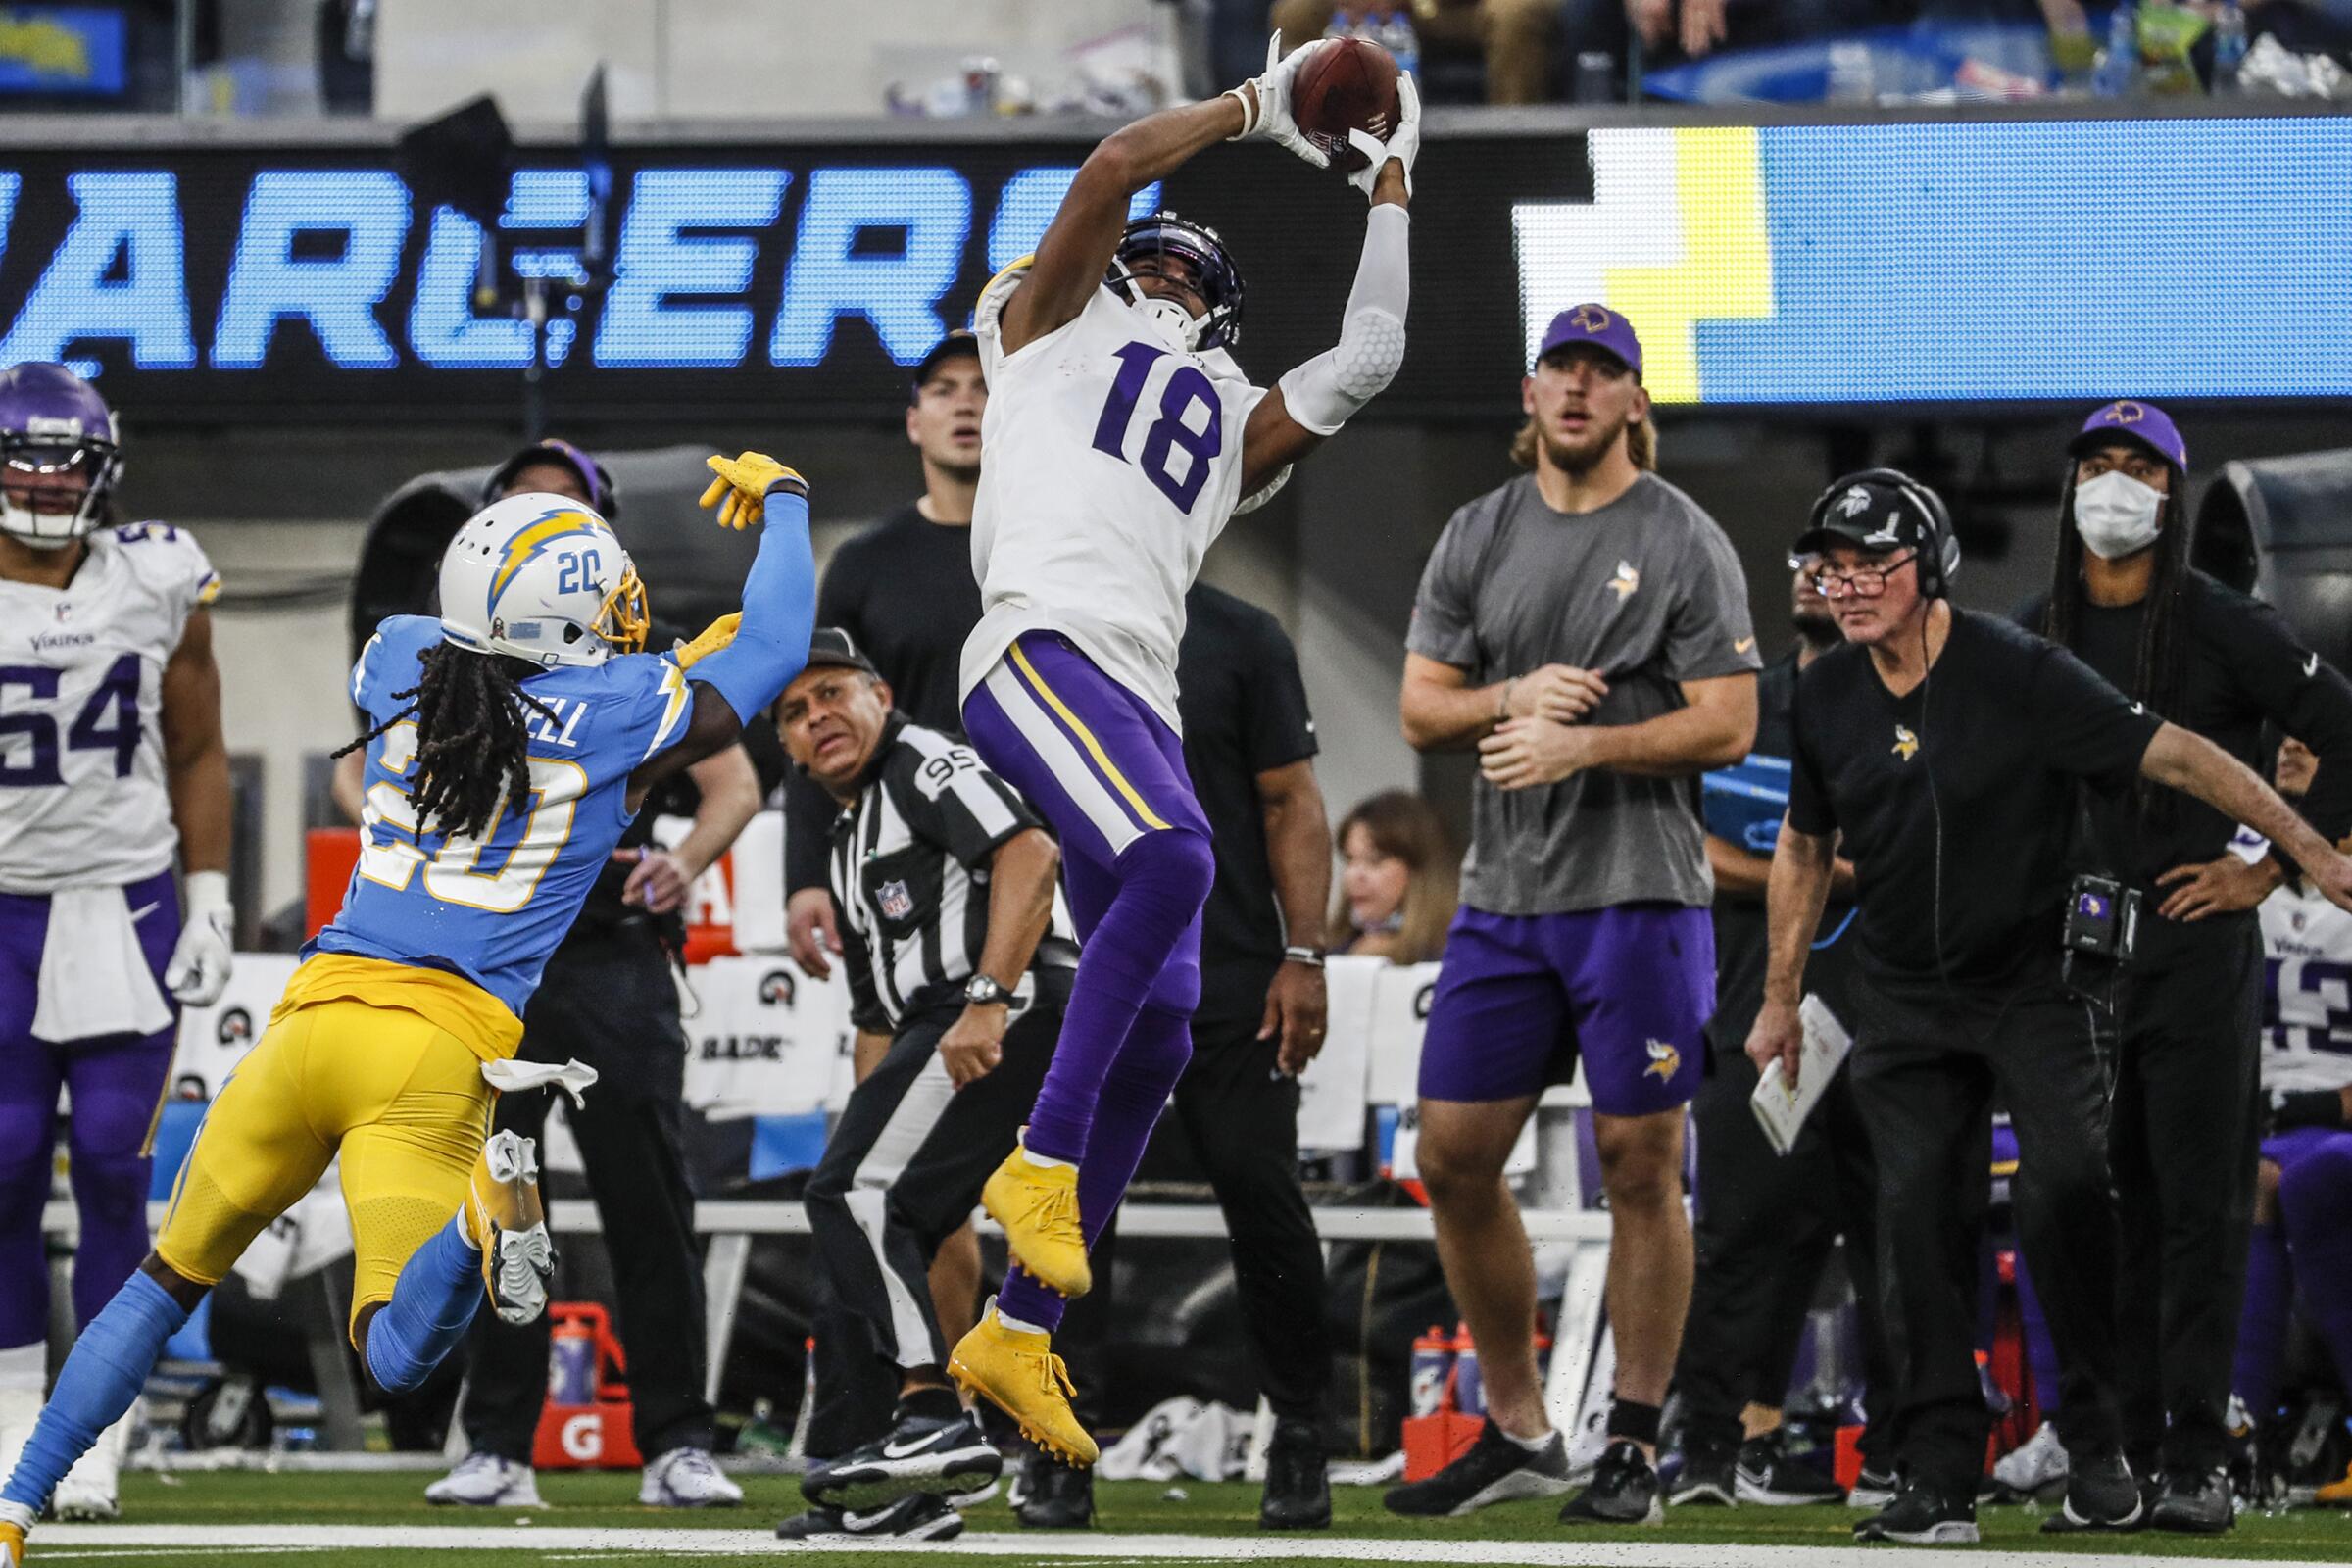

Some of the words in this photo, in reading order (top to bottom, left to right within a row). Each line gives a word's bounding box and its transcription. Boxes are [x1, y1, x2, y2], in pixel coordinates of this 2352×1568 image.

[0, 169, 1163, 370] ARGER
[1092, 340, 1222, 515] 18
[557, 548, 602, 595] 20
[510, 692, 588, 748] ELL
[925, 749, 976, 787] 95
[360, 720, 588, 914] 20
[562, 1414, 603, 1459] G
